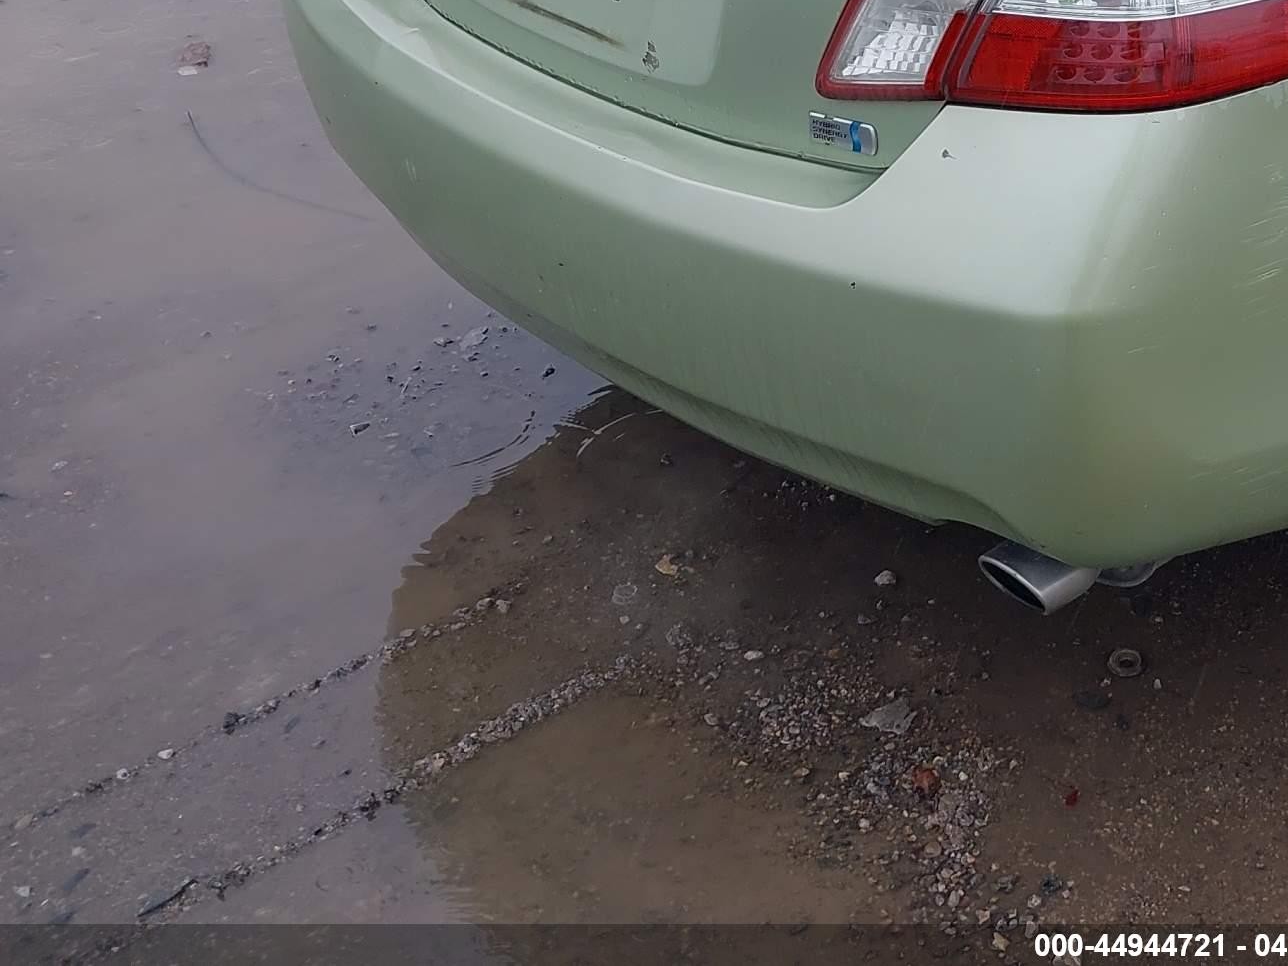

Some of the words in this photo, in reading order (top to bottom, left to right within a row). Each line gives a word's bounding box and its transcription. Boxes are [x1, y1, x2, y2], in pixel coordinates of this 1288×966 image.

[812, 119, 841, 131] HYBRID
[812, 126, 848, 139] SYNERGY
[813, 132, 835, 143] DRIVE
